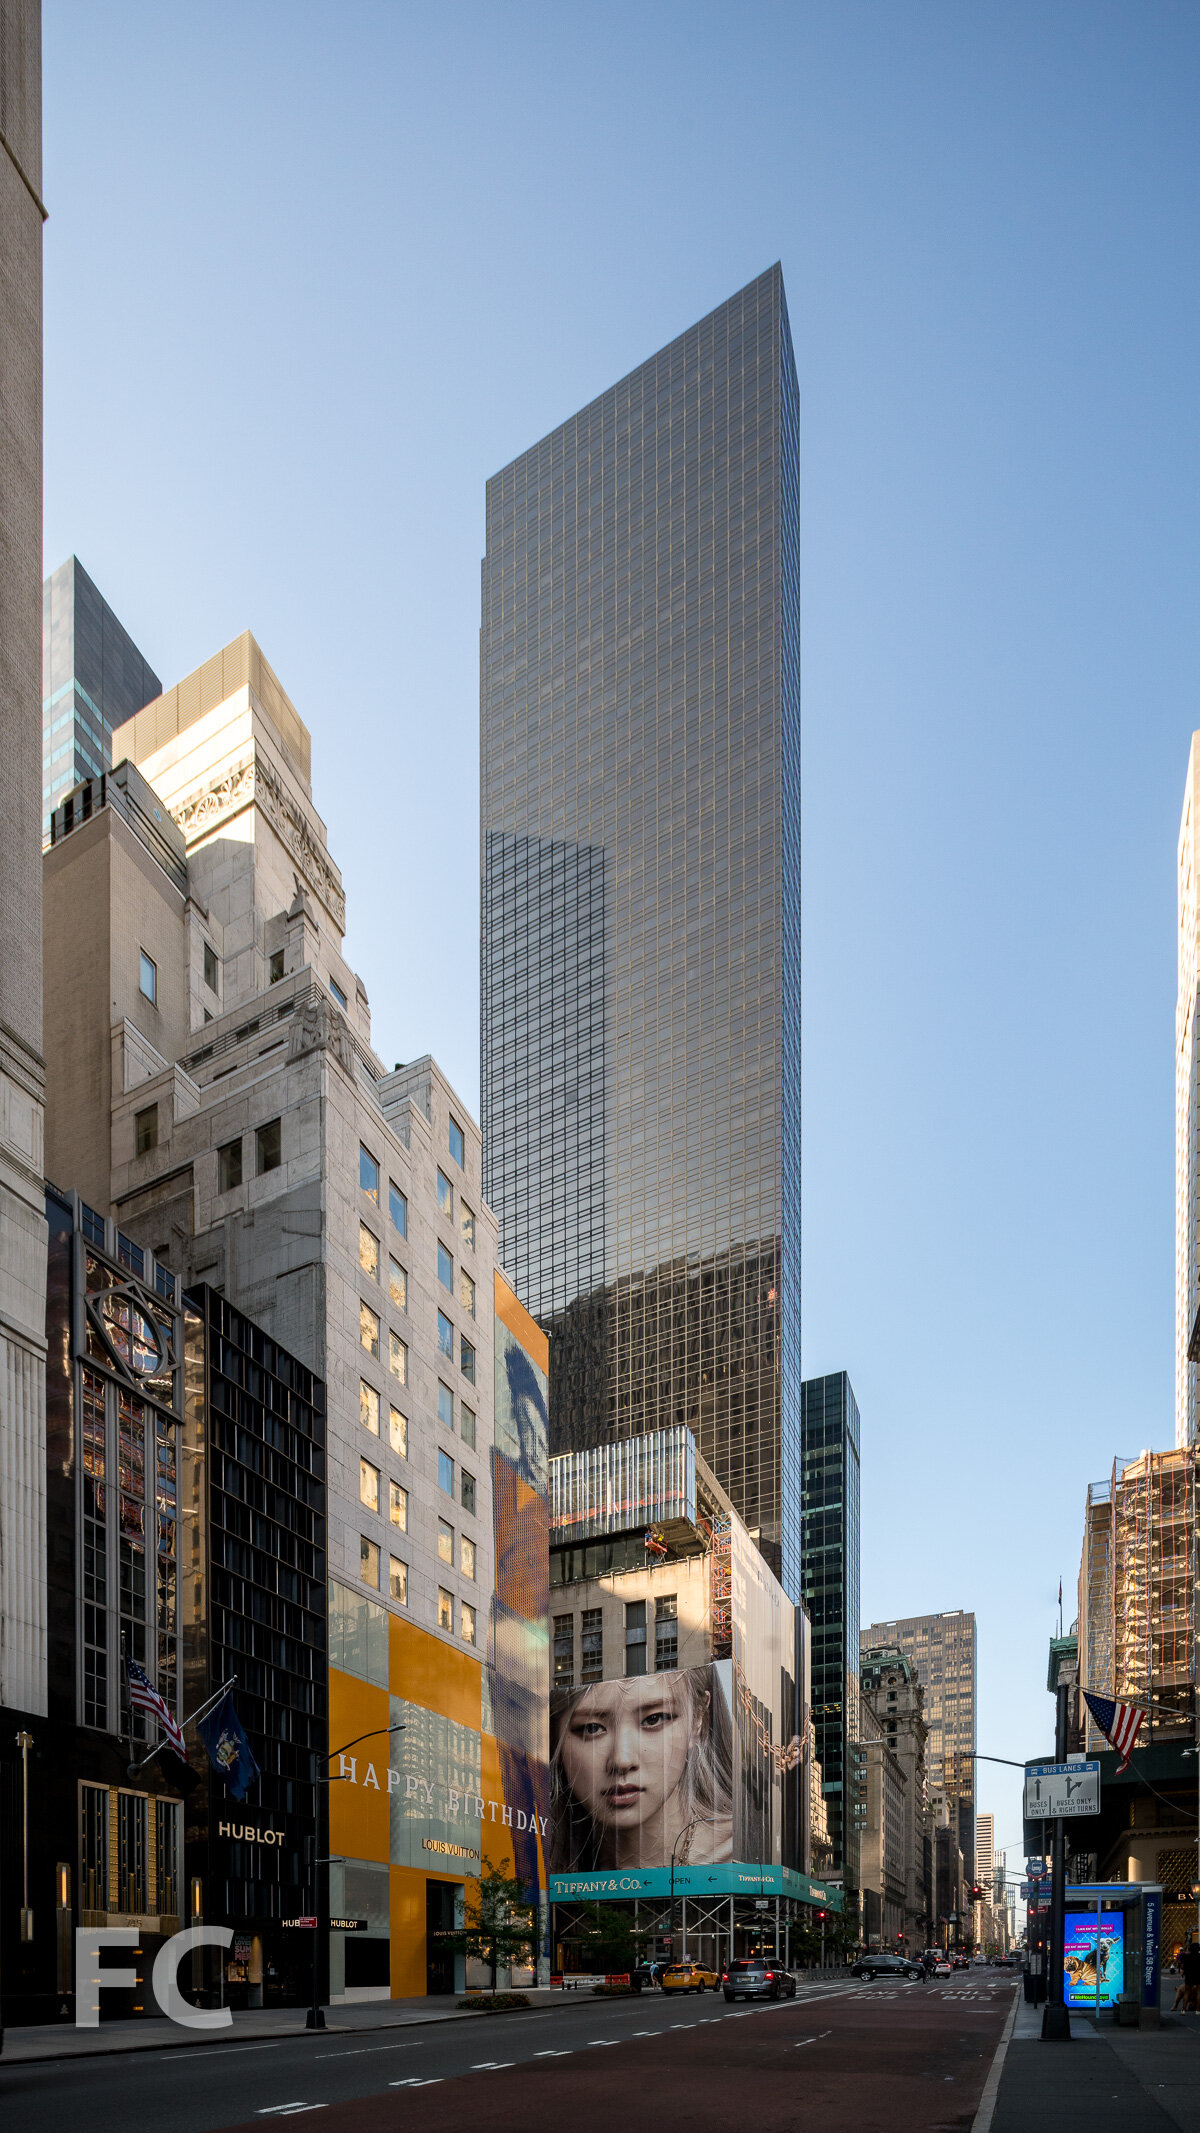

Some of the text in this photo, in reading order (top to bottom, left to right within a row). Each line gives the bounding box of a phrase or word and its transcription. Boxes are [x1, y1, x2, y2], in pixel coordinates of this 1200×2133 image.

[338, 1753, 549, 1836] HAPPY BIRTHDAY
[218, 1821, 285, 1846] HUBLOT
[421, 1838, 480, 1860] LOUIS VUITTON
[554, 1881, 607, 1894] TIFFANY
[607, 1879, 618, 1891] &
[668, 1877, 691, 1886] OPEN
[330, 1919, 358, 1928] HUBLOT
[1146, 1908, 1155, 1932] Avenue
[1146, 1939, 1154, 1956] West
[1146, 1957, 1154, 1965] 58
[1145, 1966, 1154, 1986] Street
